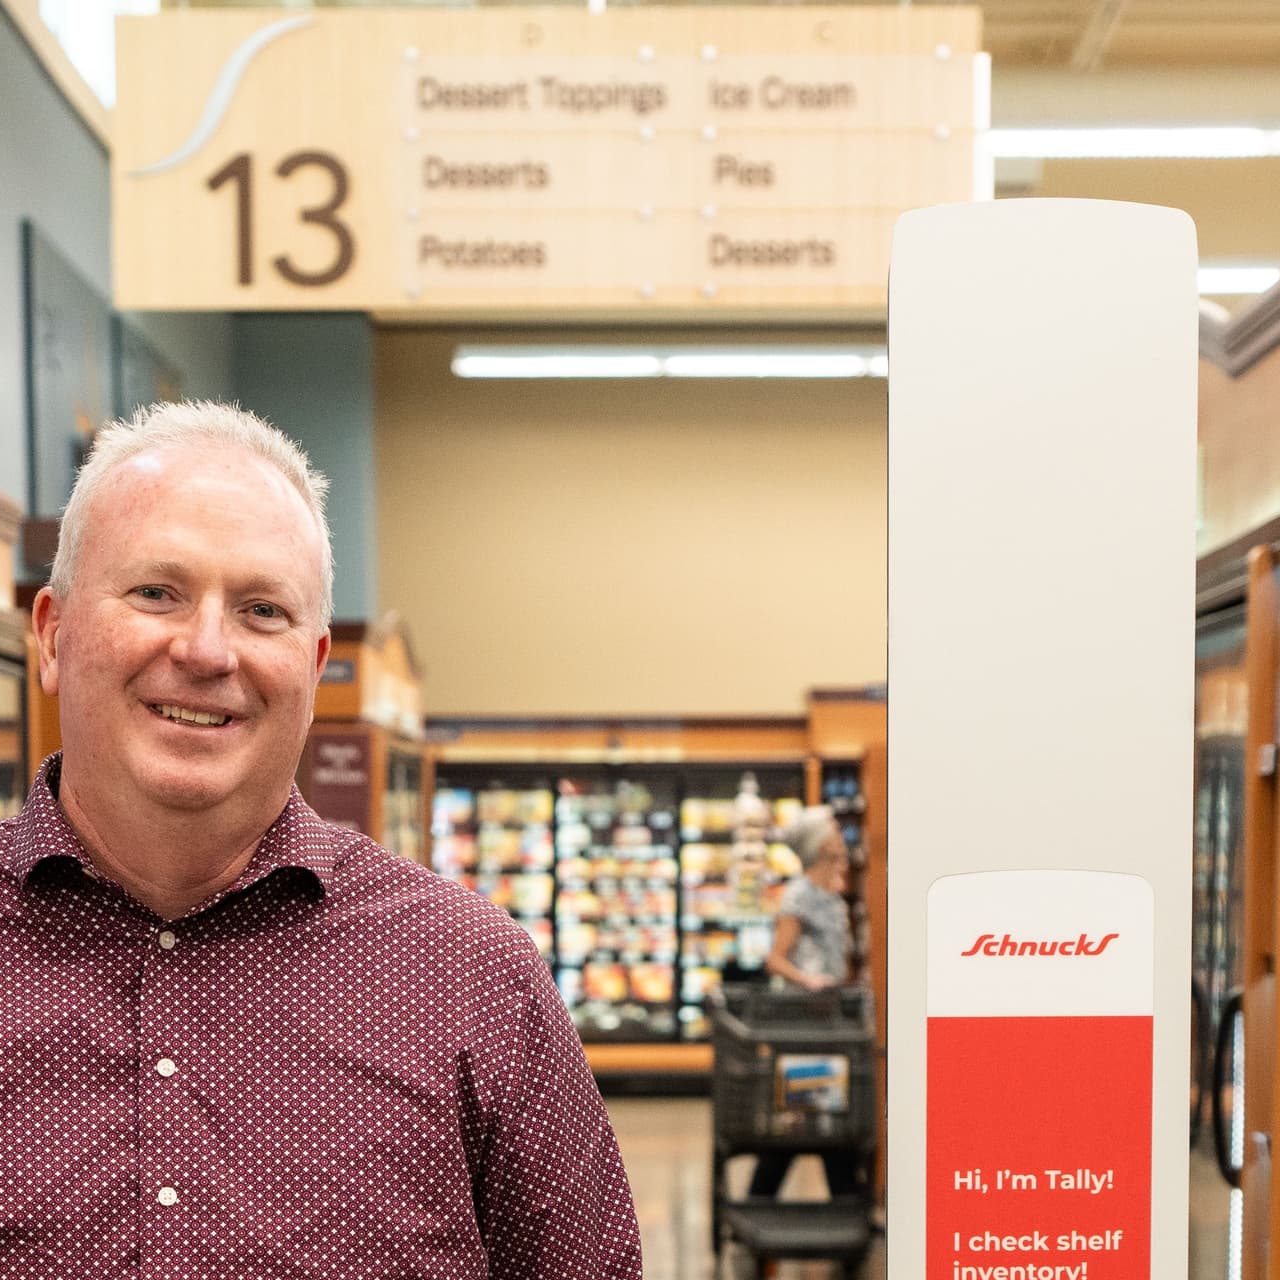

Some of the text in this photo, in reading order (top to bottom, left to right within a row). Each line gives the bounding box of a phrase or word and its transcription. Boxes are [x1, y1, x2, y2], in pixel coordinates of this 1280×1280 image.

[418, 77, 669, 114] Dessert Toppings
[710, 77, 857, 109] Ice Cream
[423, 155, 550, 189] Desserts
[714, 154, 775, 187] Pies
[205, 149, 358, 289] 13
[418, 235, 547, 268] Potatoes
[709, 234, 835, 266] Desserts
[961, 933, 1120, 957] Schnucks
[954, 1168, 1114, 1195] Hi, I'm Tally!
[954, 1230, 1124, 1252] I check shelf
